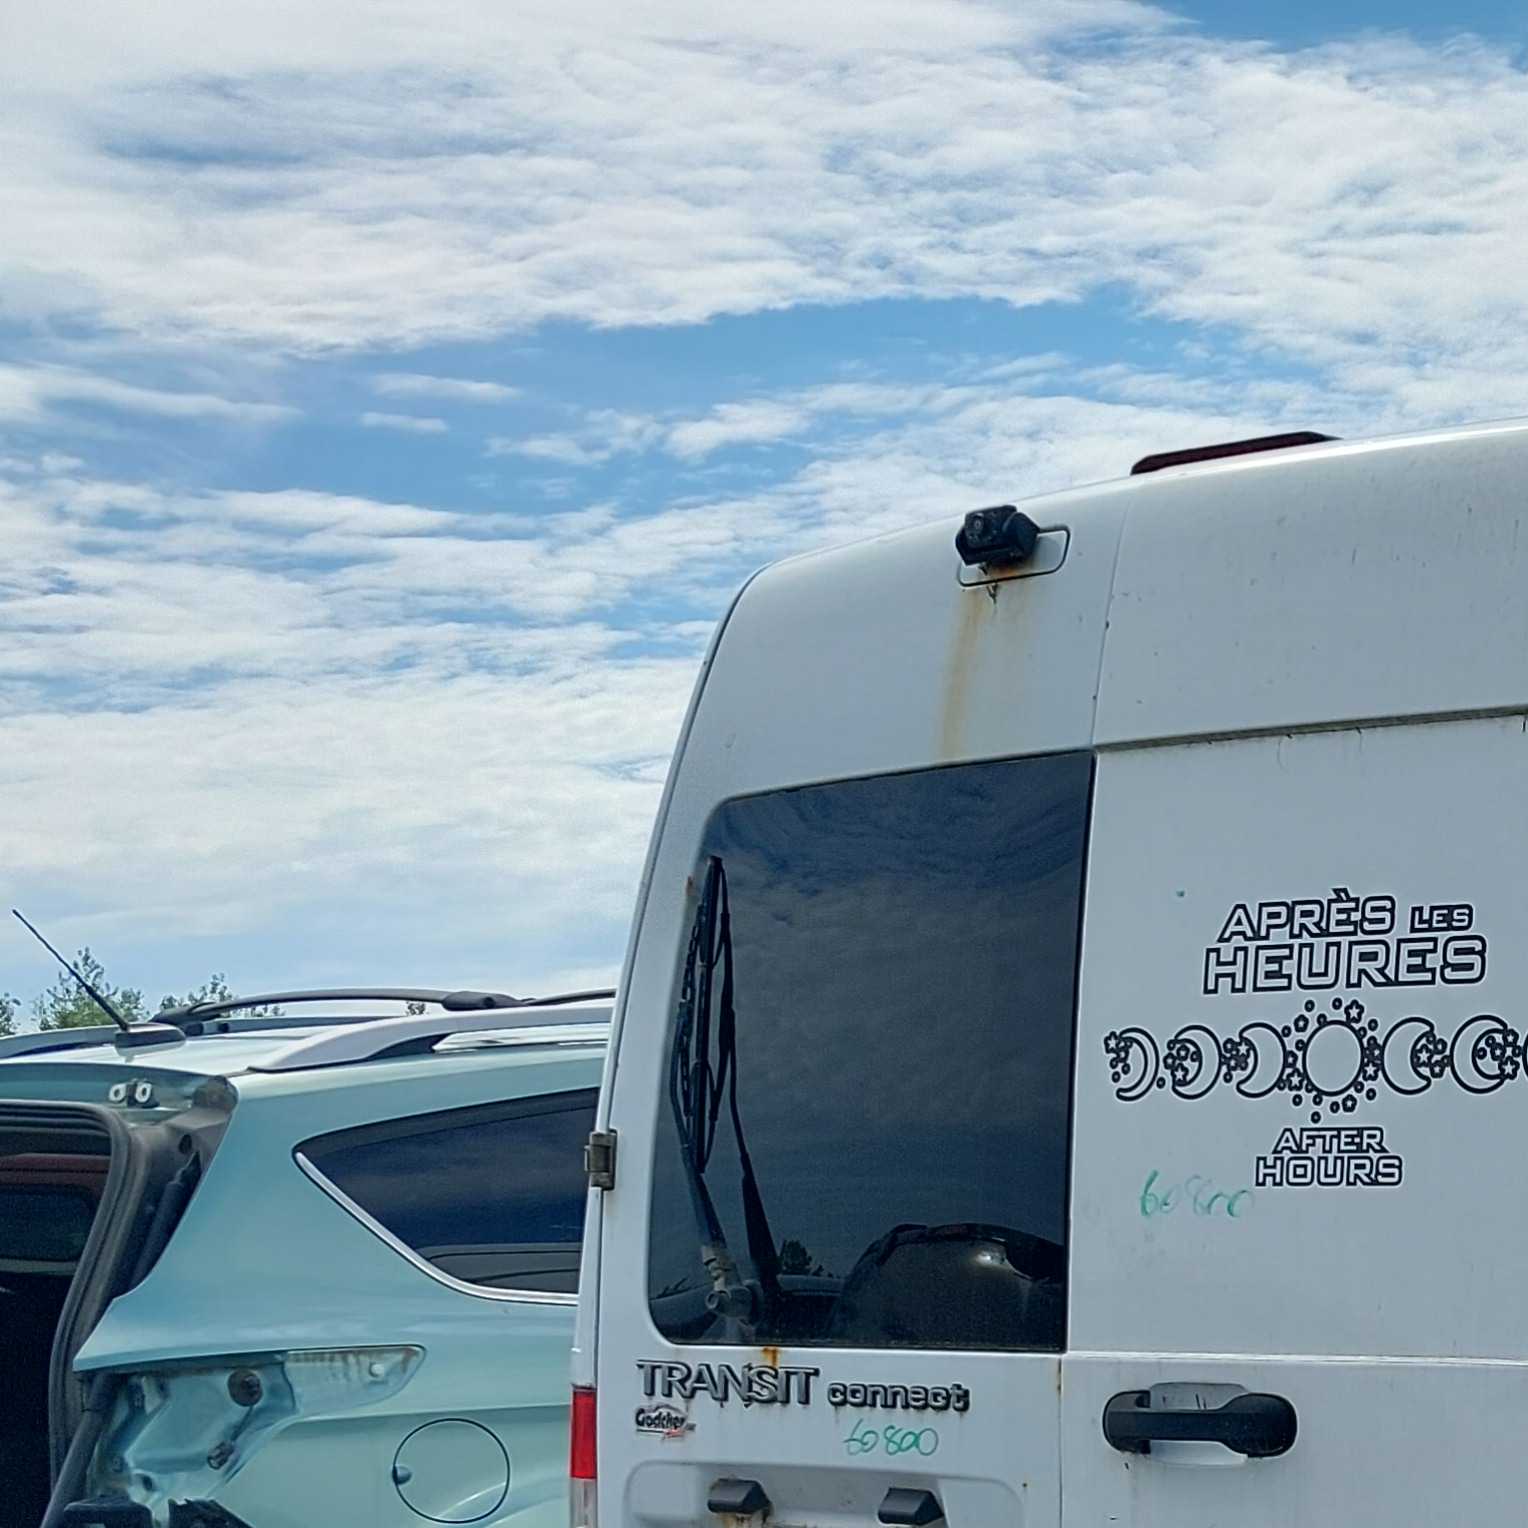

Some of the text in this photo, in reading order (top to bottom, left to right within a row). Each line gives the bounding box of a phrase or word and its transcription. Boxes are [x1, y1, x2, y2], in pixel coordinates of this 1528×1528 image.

[1216, 887, 1475, 943] APRÈS LES
[1203, 934, 1487, 995] HEURES
[1272, 1127, 1389, 1154] AFTER
[1256, 1156, 1403, 1187] HOURS
[635, 1358, 971, 1412] TRANSIT connect
[843, 1417, 939, 1457] 60800
